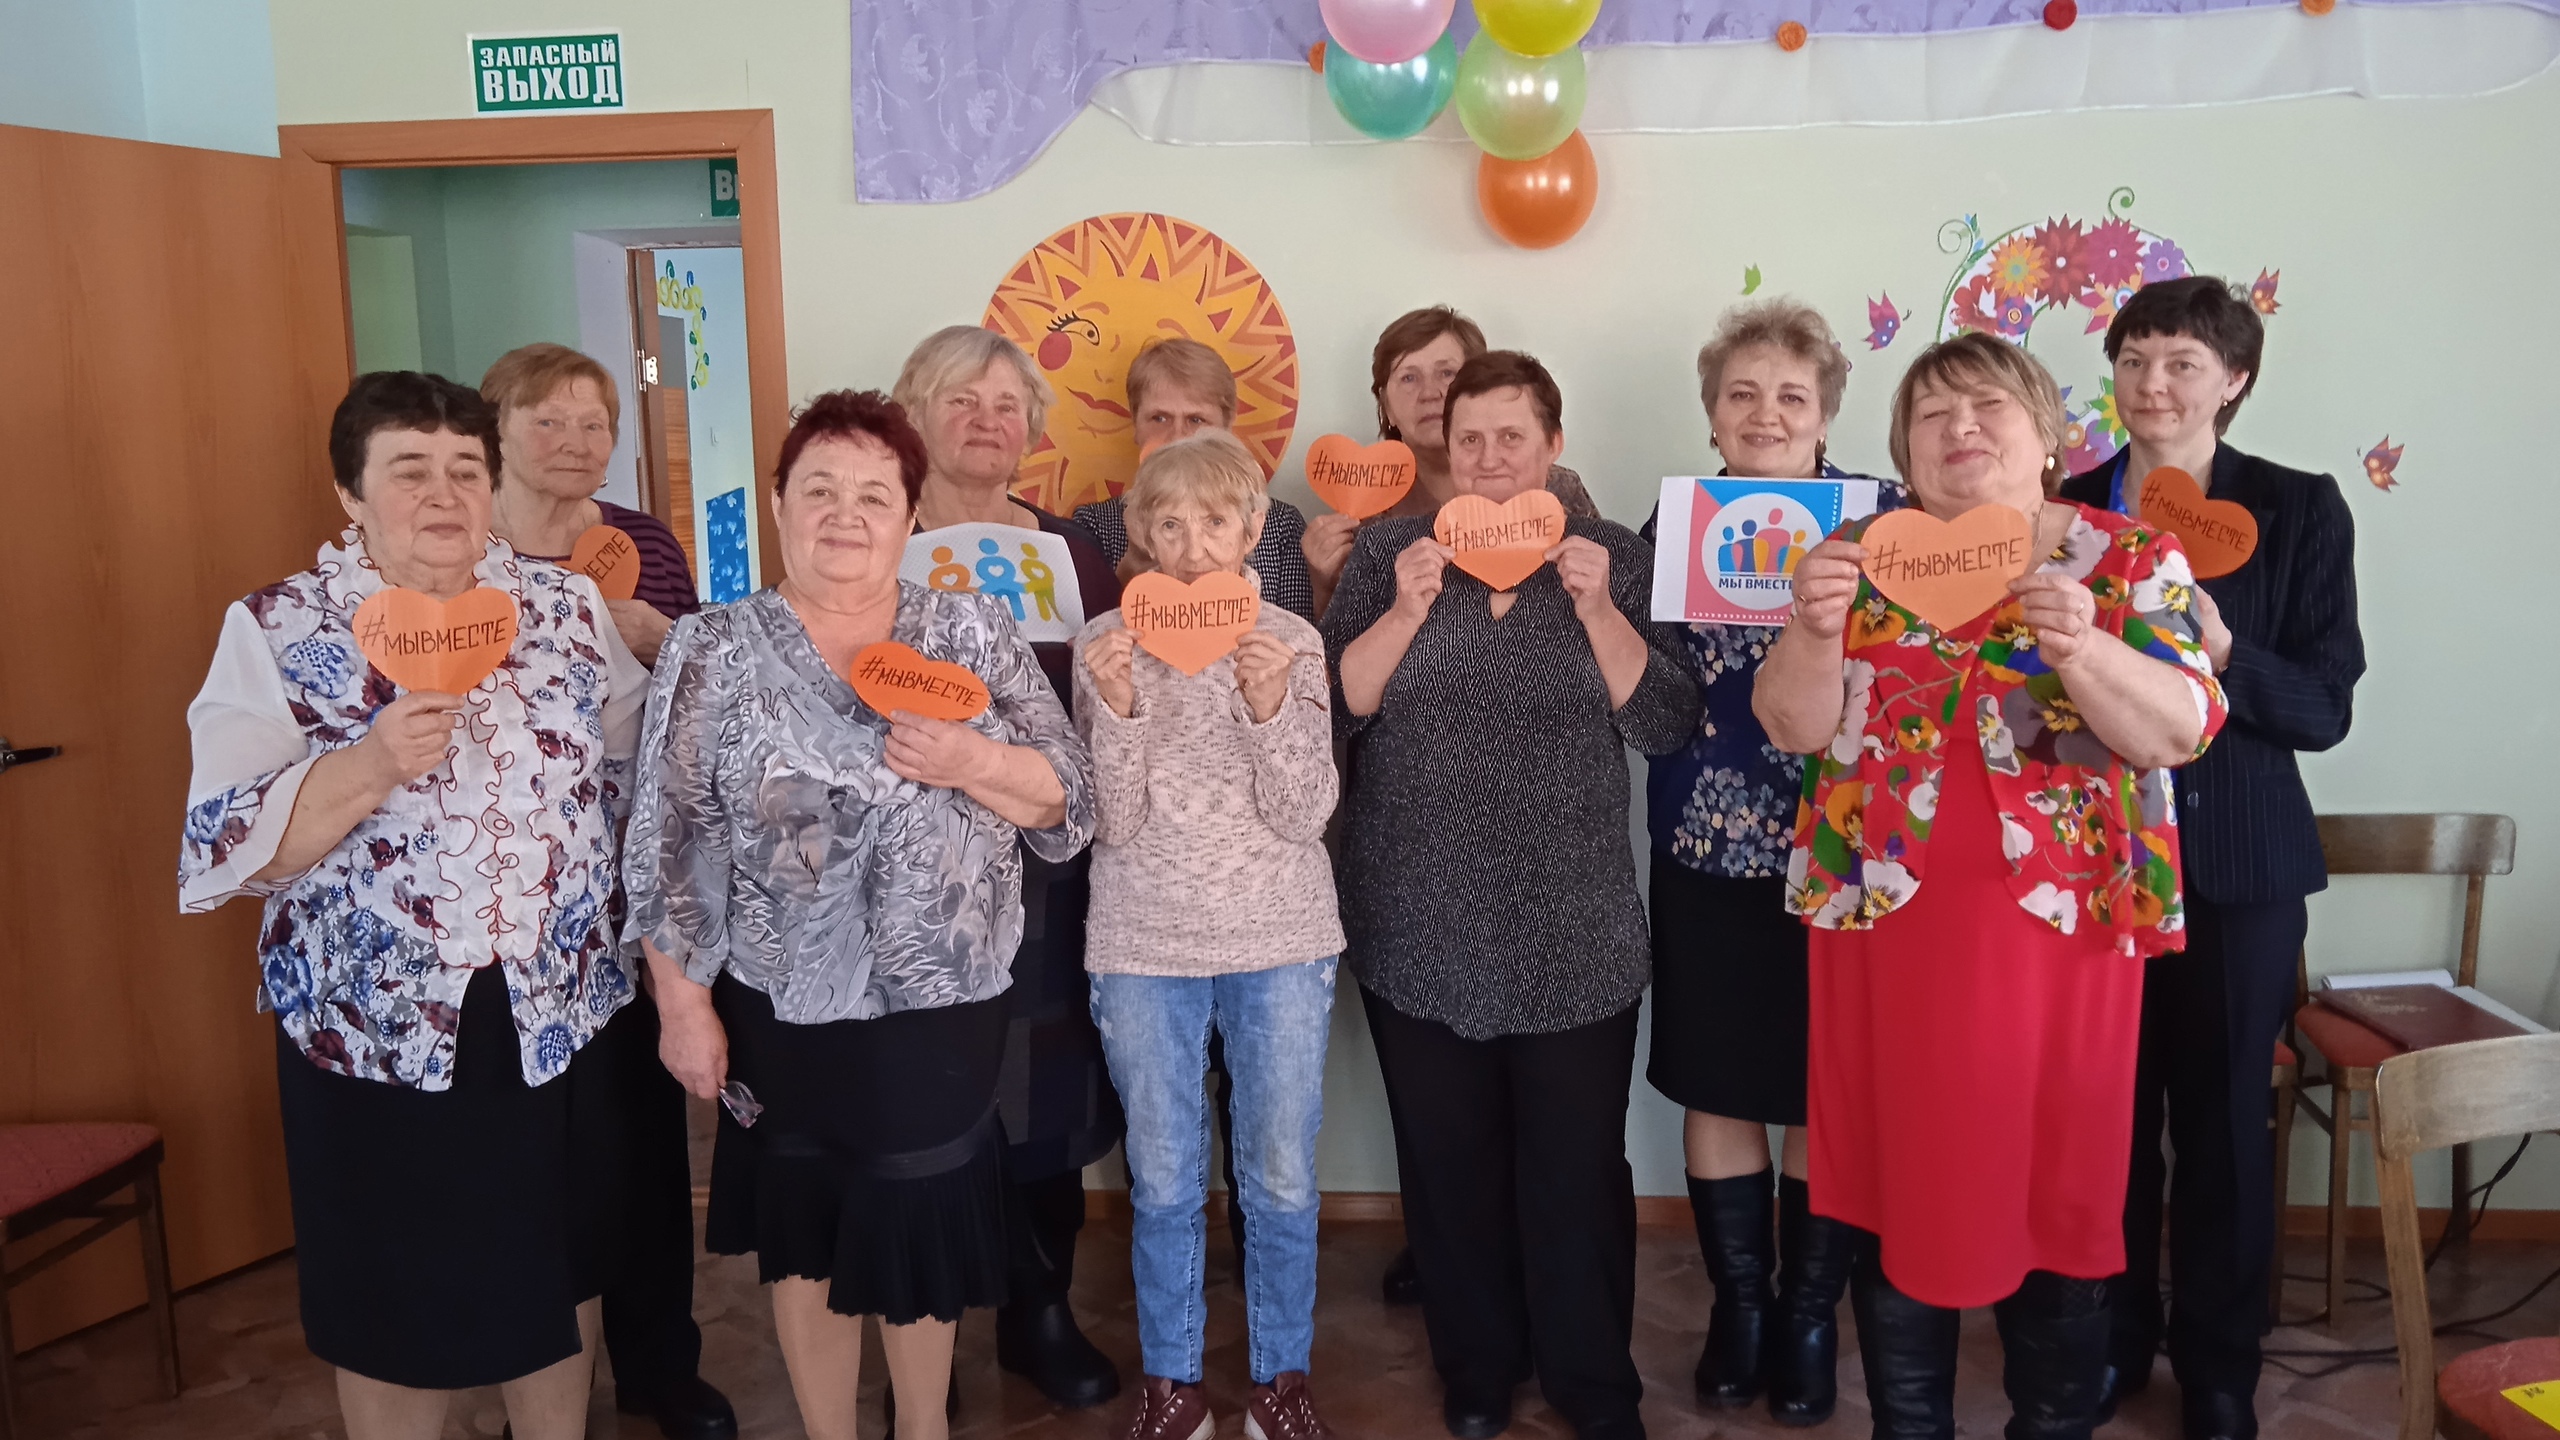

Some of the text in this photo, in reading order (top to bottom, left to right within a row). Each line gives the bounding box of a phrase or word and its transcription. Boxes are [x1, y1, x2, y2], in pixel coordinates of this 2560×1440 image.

[480, 38, 616, 67] ЗАПАСНЫЙ
[482, 65, 619, 104] ВЫХОД
[1312, 449, 1409, 488] #МЫВМЕСТЕ
[1444, 514, 1554, 553] #МЫВМЕСТЕ
[2140, 479, 2249, 553] #МЫВМЕСТЕ
[1873, 537, 2024, 581] #МЫВМЕСТЕ
[1718, 577, 1742, 589] МЫ
[1130, 594, 1251, 631] #МЫВМЕСТЕ
[361, 613, 509, 657] #МЫВМЕСТЕ
[859, 655, 984, 708] #МЫВМЕСТЕ
